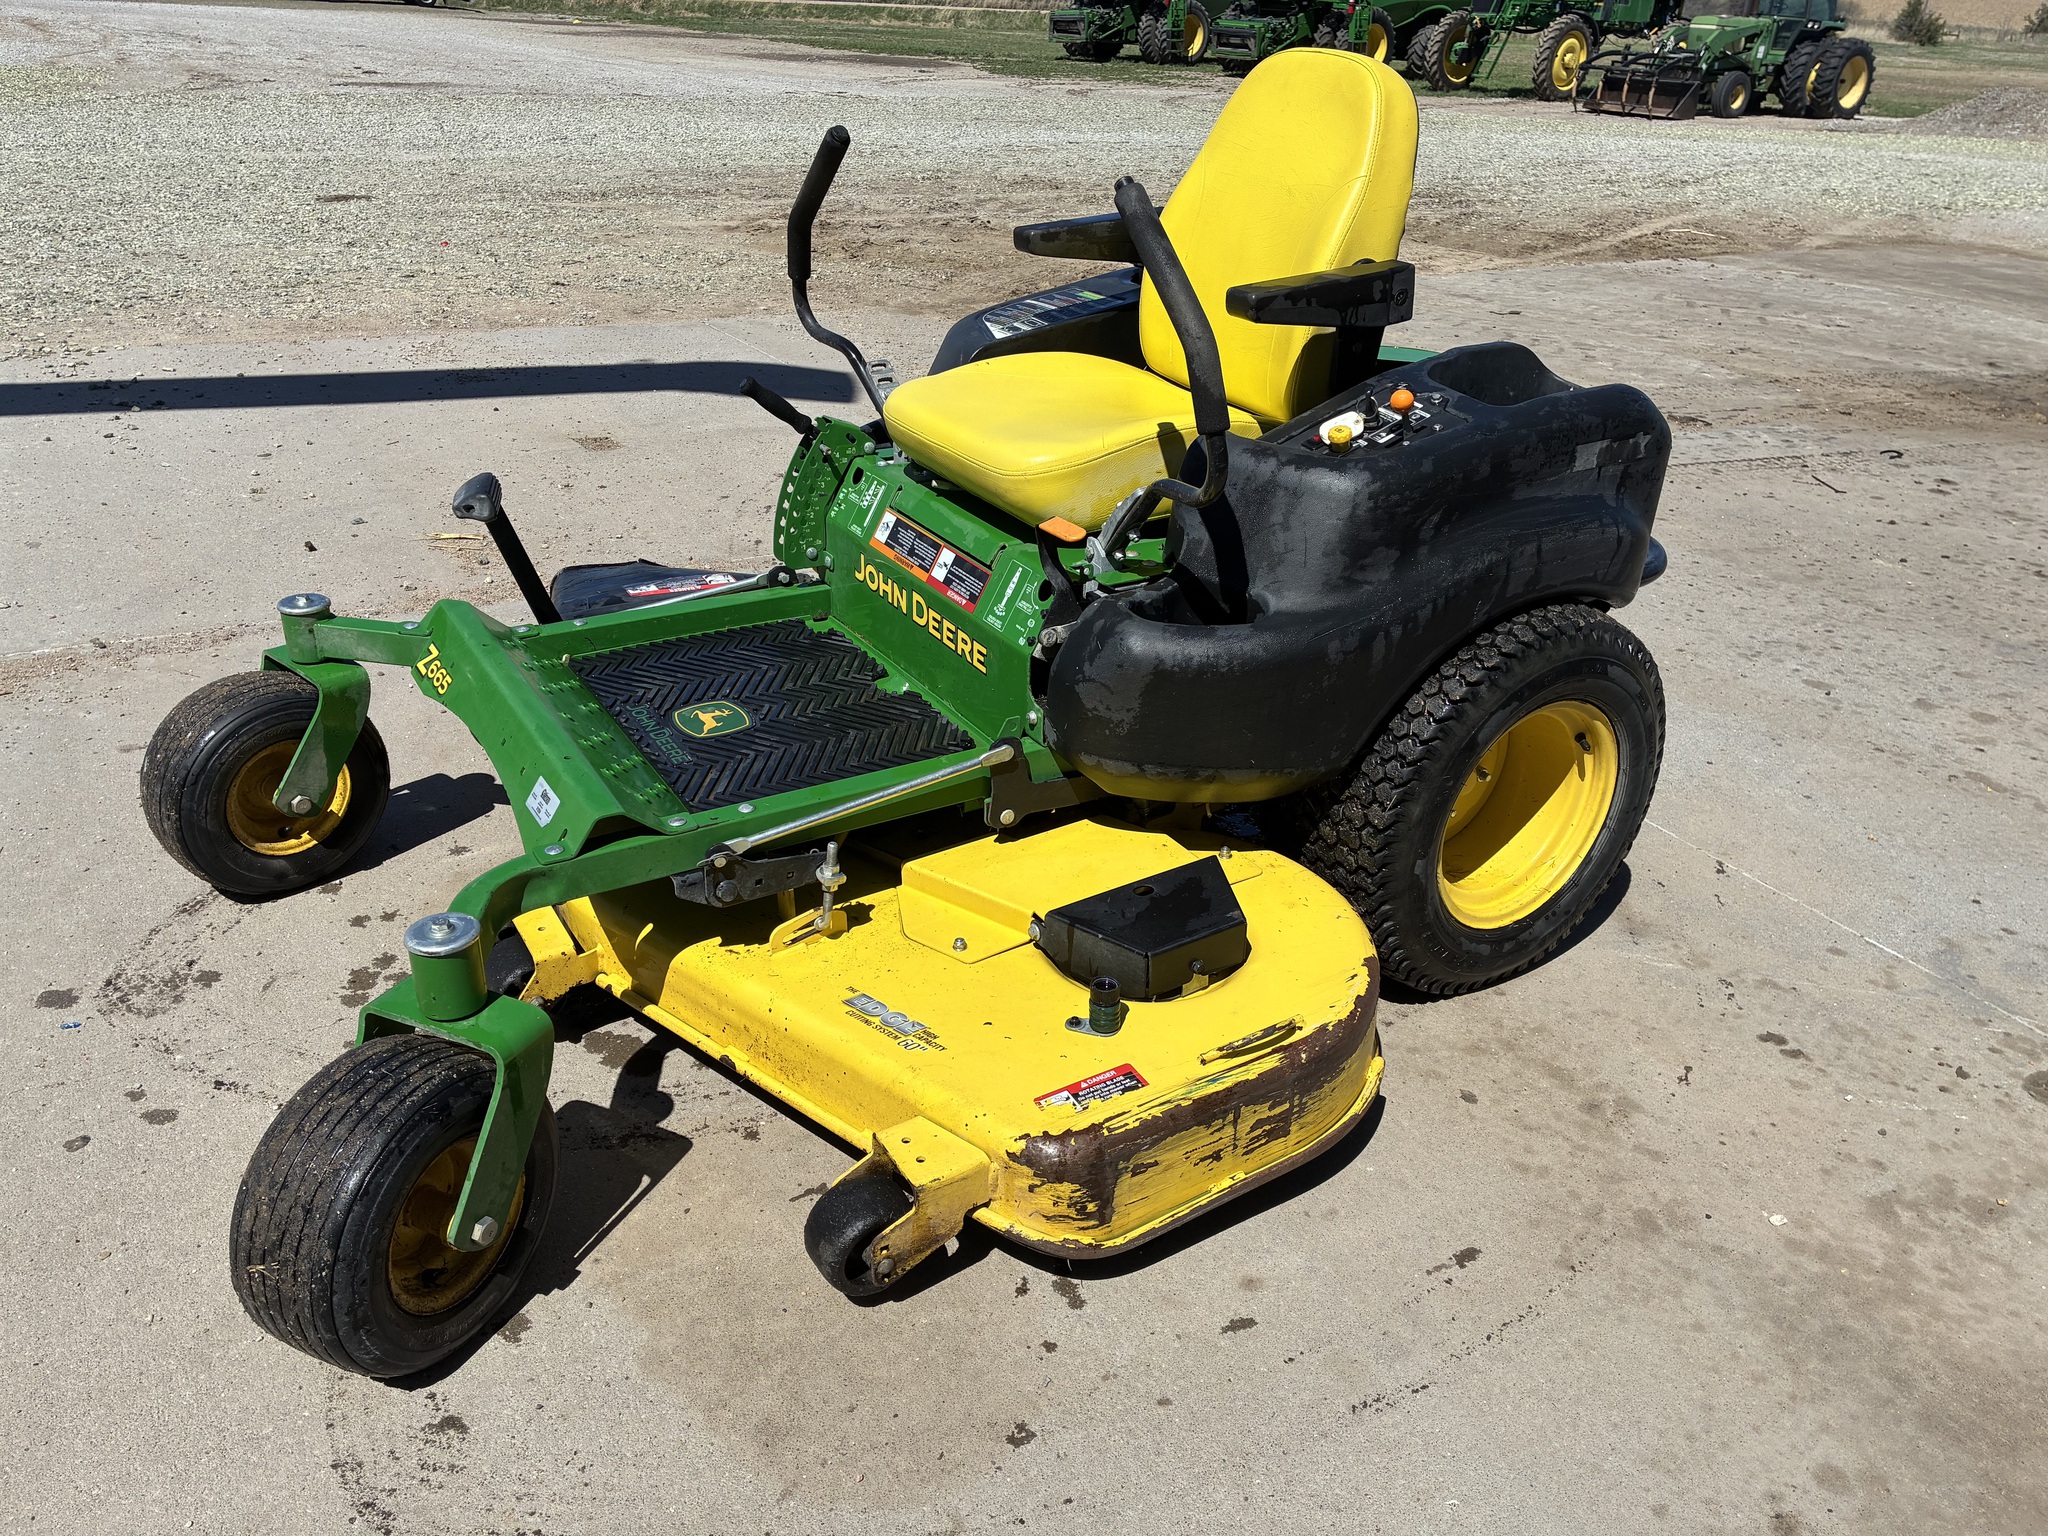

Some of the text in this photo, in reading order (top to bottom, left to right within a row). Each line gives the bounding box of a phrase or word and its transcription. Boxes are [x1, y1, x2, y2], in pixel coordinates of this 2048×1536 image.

[854, 553, 908, 616] JOHN
[911, 591, 988, 675] DEERE
[416, 642, 453, 695] Z665
[626, 704, 691, 765] JOHN DEERE
[845, 986, 860, 994] THE
[841, 992, 928, 1037] EDGE
[845, 1010, 928, 1052] CUTTING SYSTEM 60"
[912, 1033, 947, 1052] CAPACITY
[921, 1029, 940, 1040] HIGH
[1078, 1082, 1106, 1096] ROTATING
[1105, 1076, 1125, 1085] BLADE
[1086, 1070, 1117, 1085] DANGER
